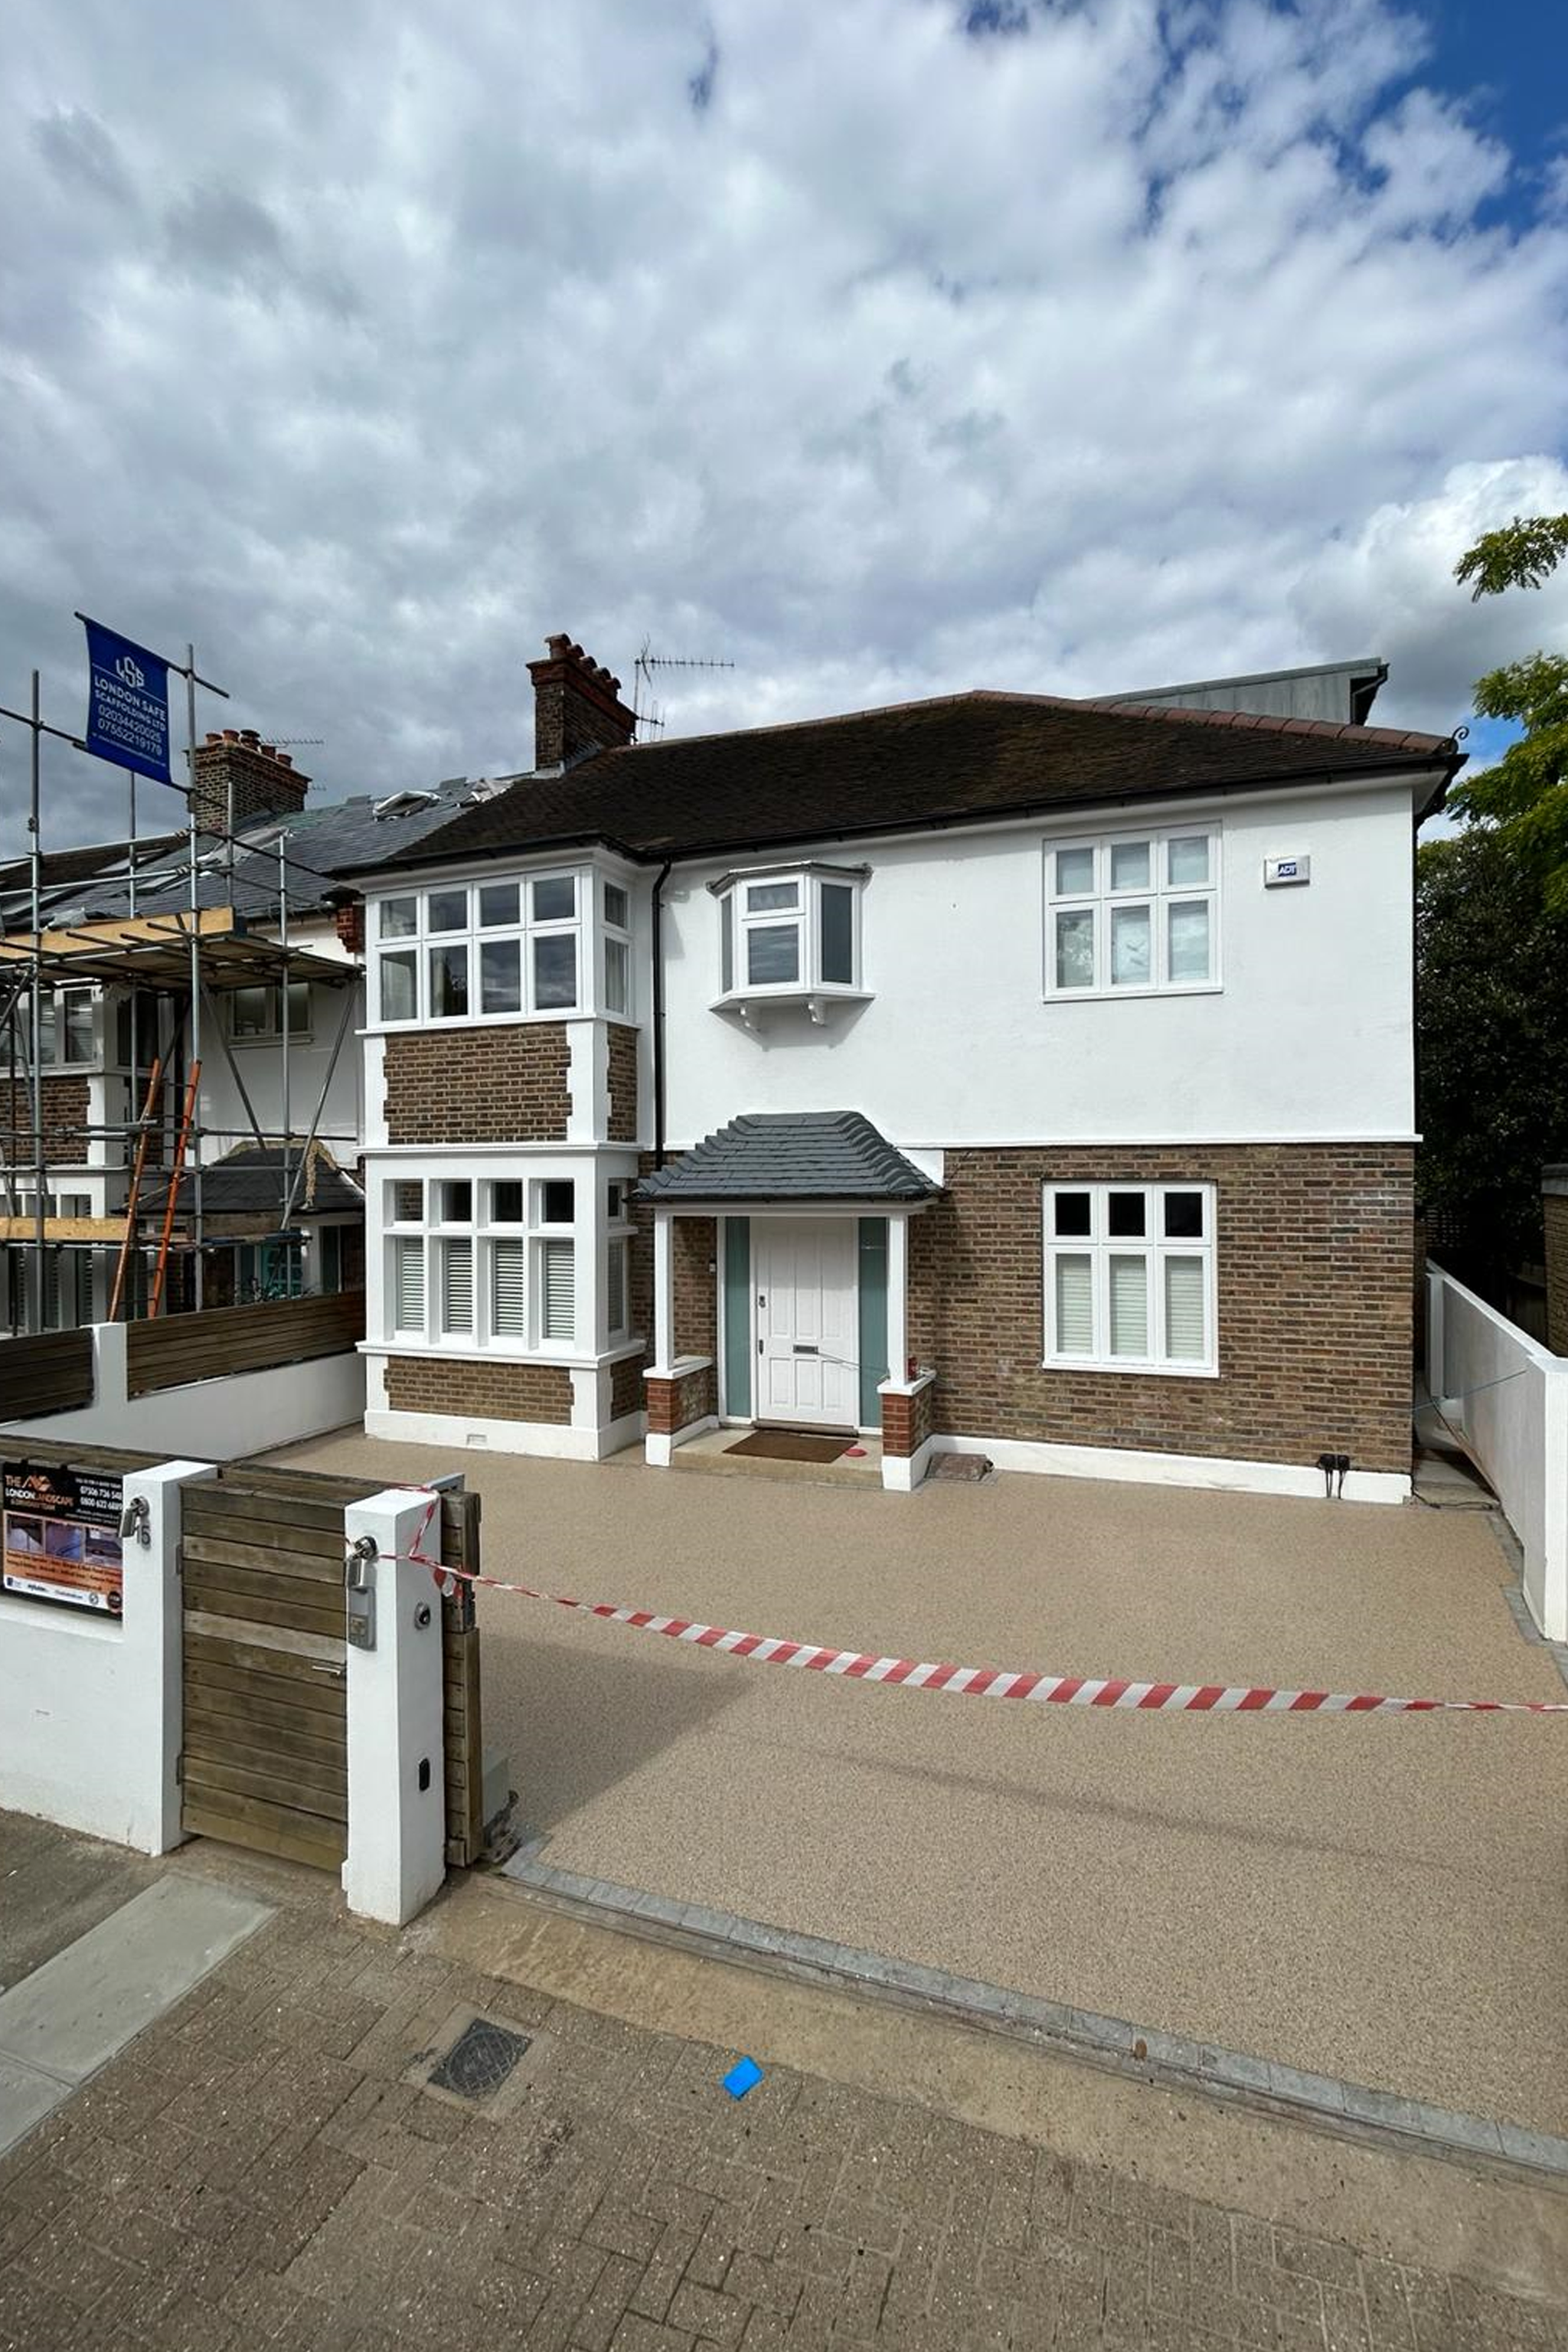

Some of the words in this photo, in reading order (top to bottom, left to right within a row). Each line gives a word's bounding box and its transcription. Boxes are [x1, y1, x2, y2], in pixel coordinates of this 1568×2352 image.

[94, 675, 139, 707] LONDON
[142, 701, 166, 722] SAFE
[95, 690, 152, 724] SCAFFOLDING
[152, 719, 166, 732] LTD
[1279, 864, 1295, 874] ADT
[5, 1475, 22, 1488] THE
[5, 1488, 36, 1500] LONDON
